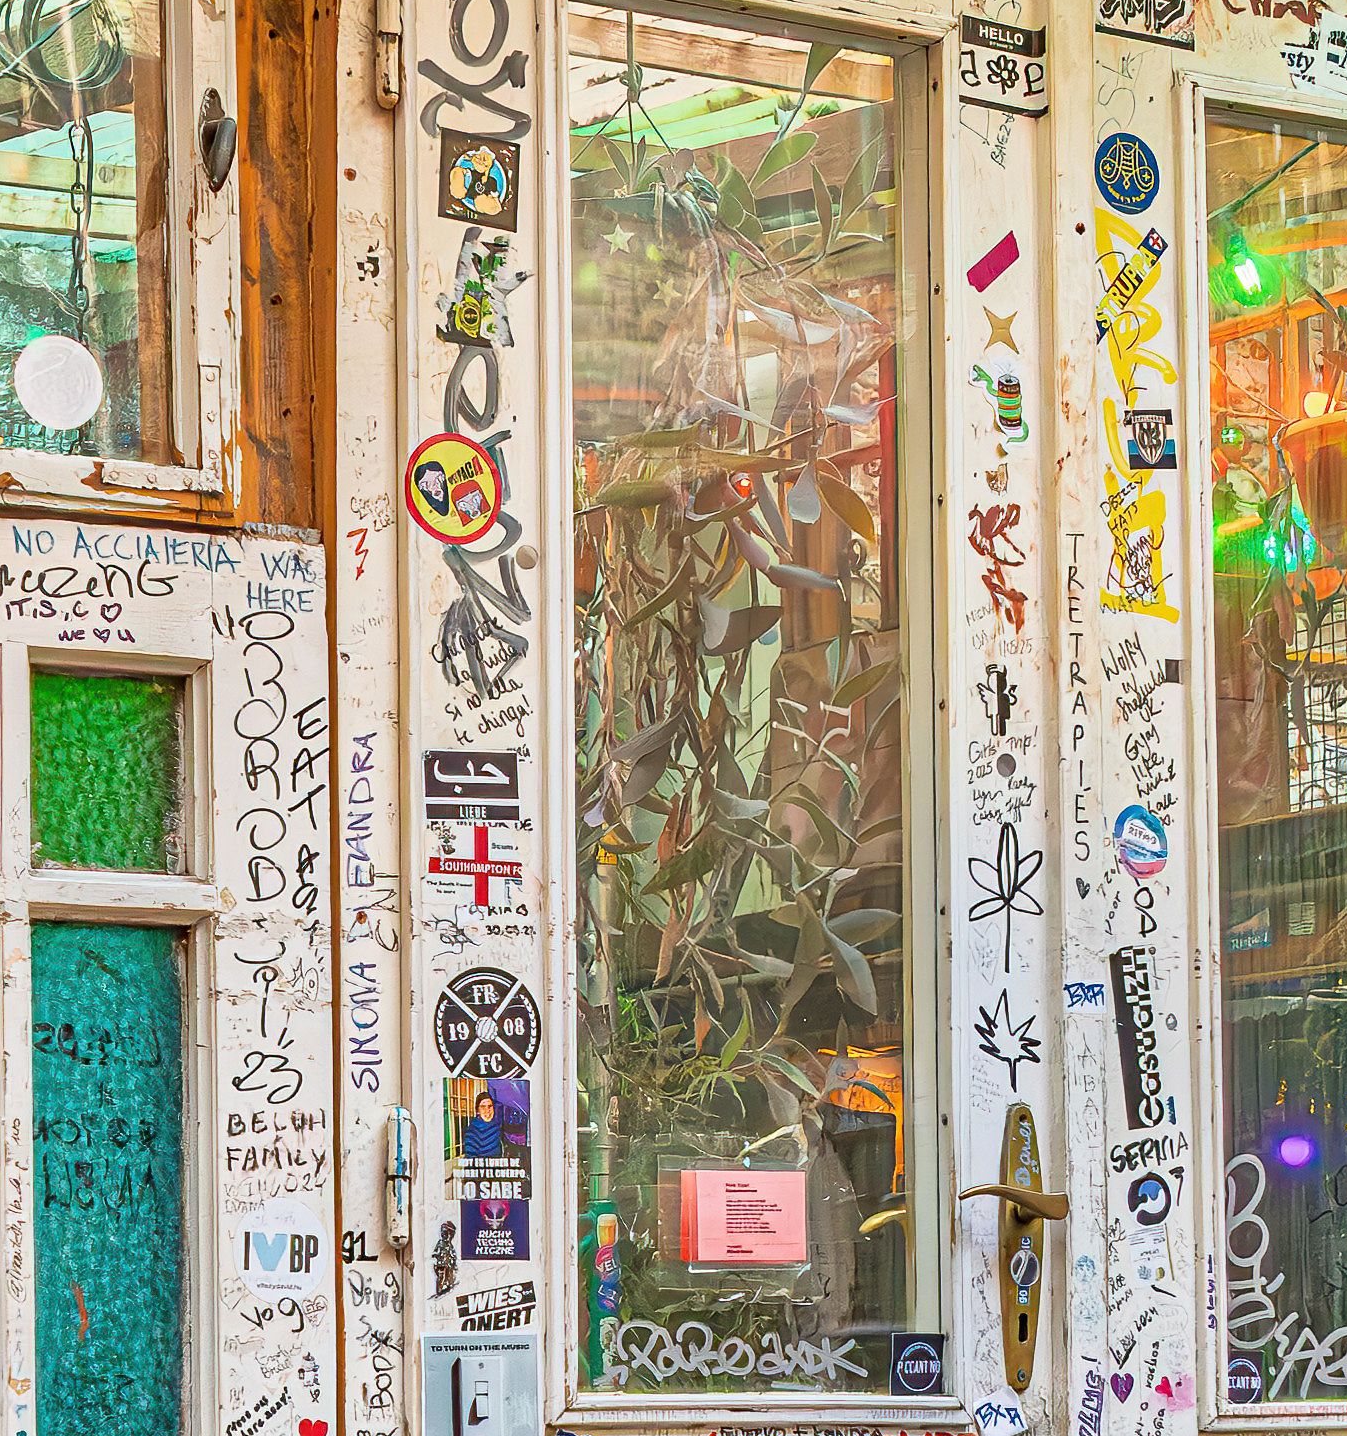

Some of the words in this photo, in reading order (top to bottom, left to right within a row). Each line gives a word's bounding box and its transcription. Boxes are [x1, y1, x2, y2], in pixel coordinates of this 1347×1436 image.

[978, 25, 1025, 46] HELLO
[246, 585, 315, 614] HERE
[459, 806, 487, 819] LIEBE
[438, 861, 509, 877] SOUTHAMPTON
[448, 1023, 469, 1042] 19
[503, 1018, 525, 1037] 08
[477, 1053, 502, 1075] FC
[480, 1180, 523, 1200] SABE
[289, 1232, 320, 1275] BP
[444, 1343, 466, 1352] TURN
[469, 1343, 481, 1352] ON
[482, 1343, 499, 1352] THE
[501, 1343, 530, 1352] MUSIC
